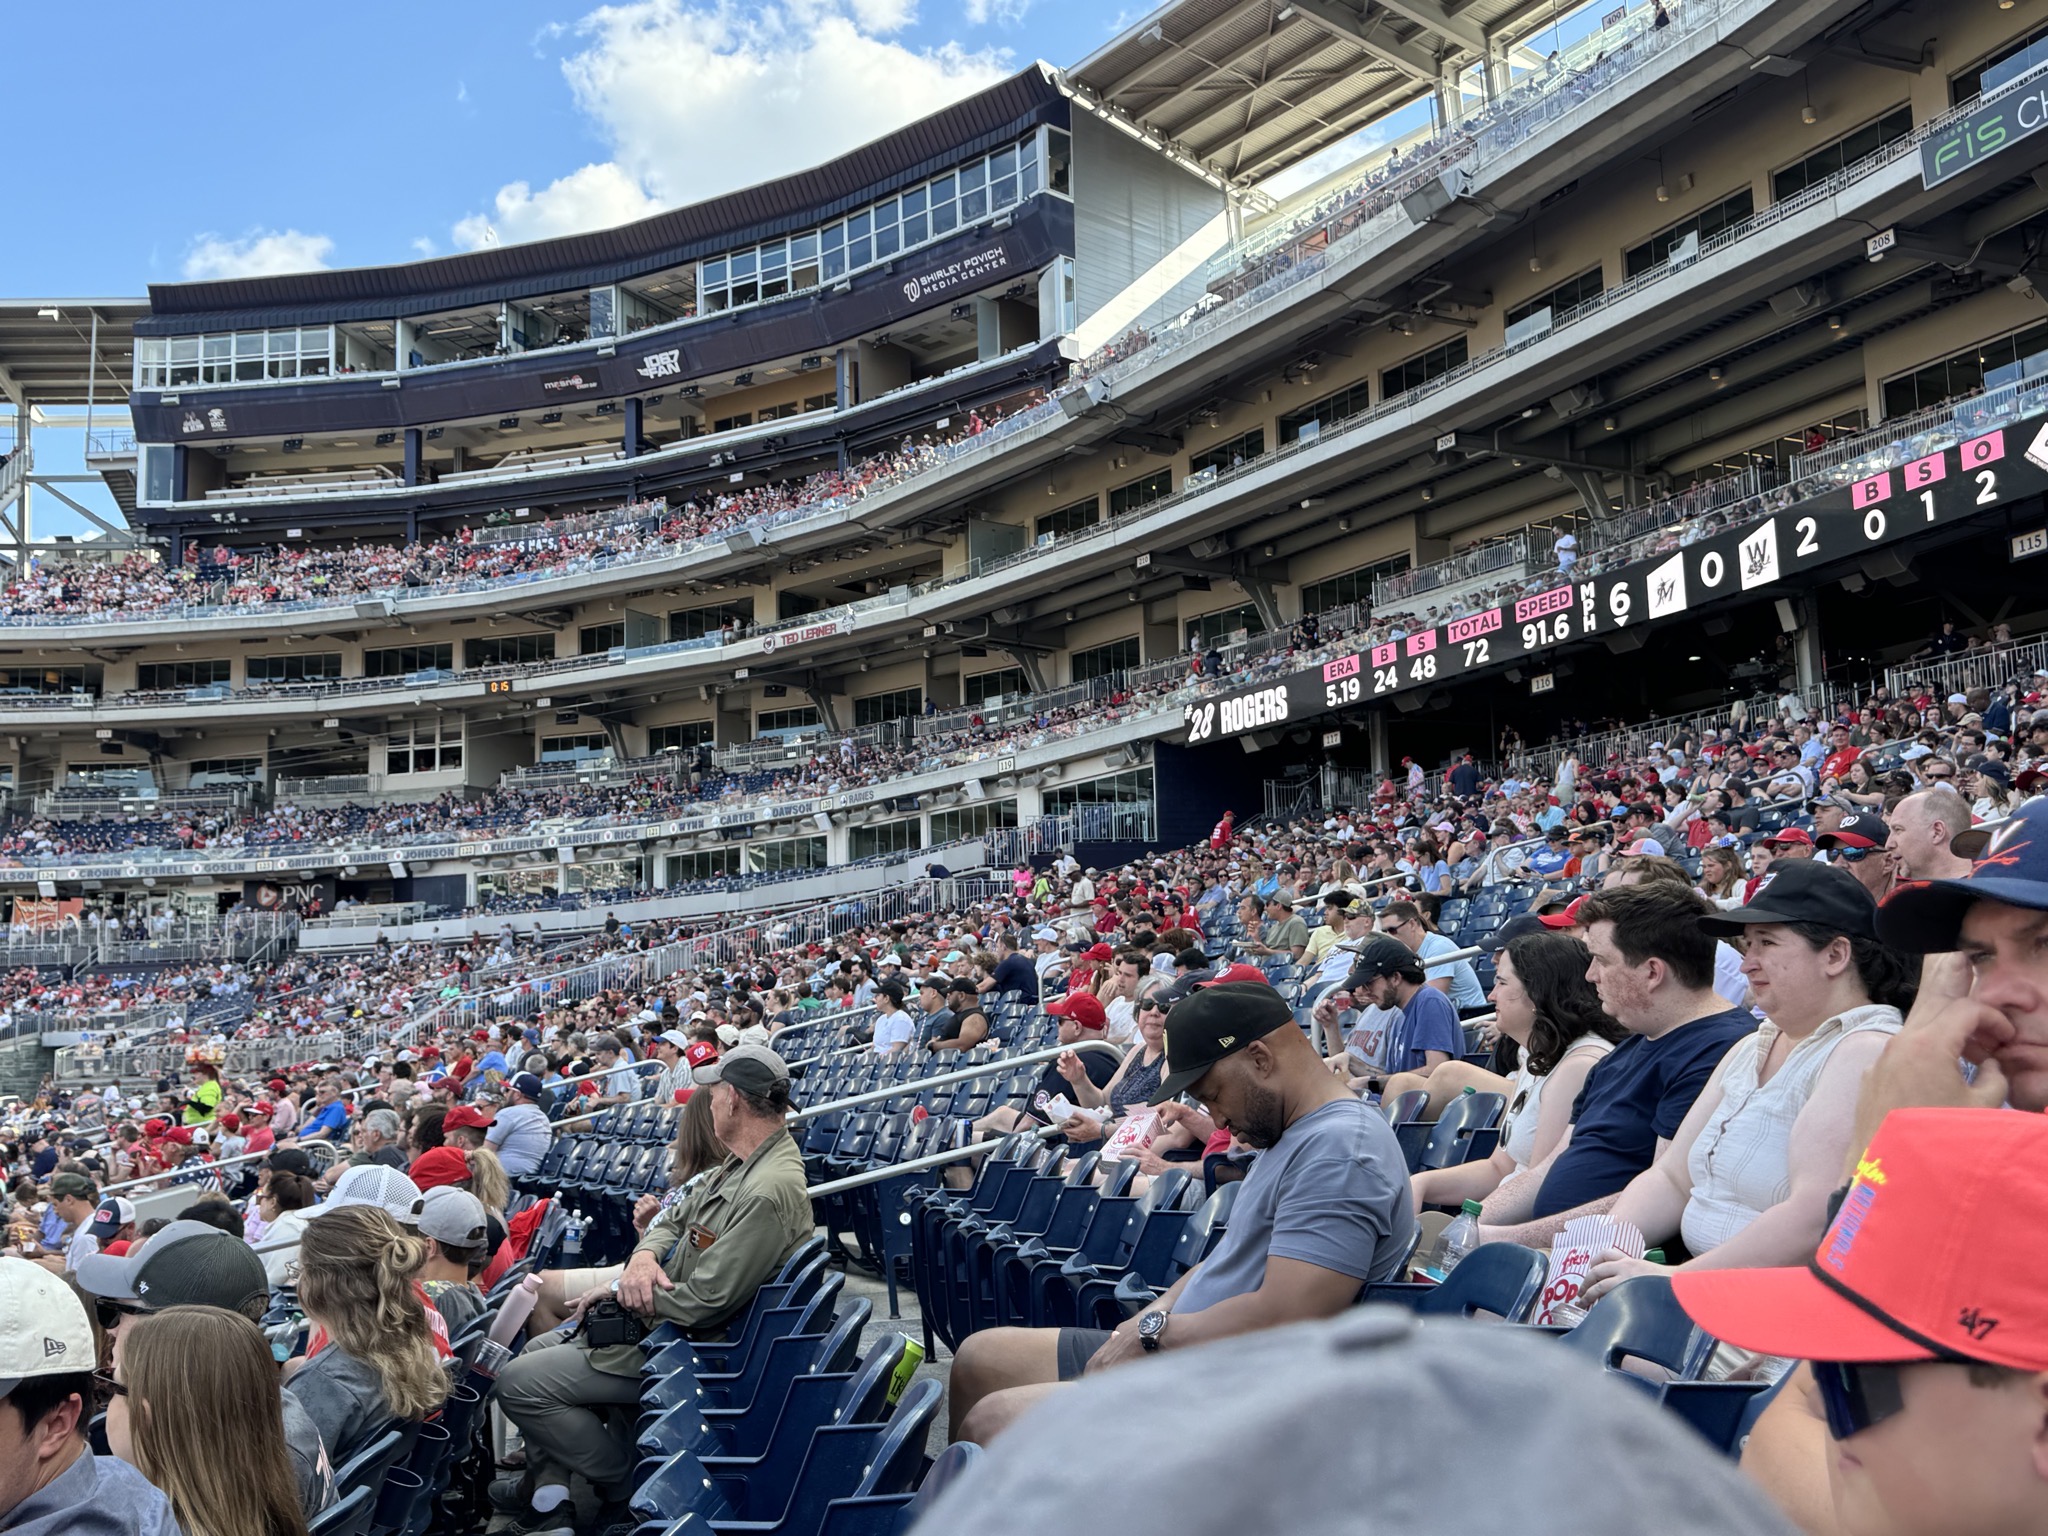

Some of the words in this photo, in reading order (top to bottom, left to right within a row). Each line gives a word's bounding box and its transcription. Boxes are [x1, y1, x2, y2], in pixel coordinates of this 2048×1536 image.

[1872, 234, 1891, 250] 208
[920, 262, 961, 286] SHIRLEY
[959, 246, 1004, 269] POVICH
[923, 276, 954, 295] MEDIA
[956, 257, 1007, 281] CENTER
[649, 361, 681, 379] FAN
[1440, 435, 1453, 448] 209
[1867, 482, 1878, 499] B
[1919, 464, 1932, 481] S
[1974, 440, 1991, 461] O
[1864, 509, 1886, 540] 0
[1920, 489, 1936, 522] 1
[1976, 470, 1998, 505] 2
[1796, 516, 1819, 557] 2
[2018, 534, 2043, 553] 115
[1139, 556, 1148, 565] 210
[1700, 551, 1724, 588] 0
[1609, 581, 1631, 613] 6
[1580, 581, 1597, 633] MPH
[781, 633, 799, 646] TED
[801, 624, 837, 643] LERNER
[1329, 661, 1354, 677] ERA
[1380, 648, 1389, 663] B
[1417, 635, 1426, 650] S
[1450, 617, 1500, 641] TOTAL
[1518, 590, 1570, 619] SPEED
[1326, 677, 1360, 707] 5.19
[1373, 667, 1398, 694] 24
[1410, 654, 1436, 682] 48
[1462, 639, 1490, 668] 72
[1522, 613, 1570, 650] 91.6
[1535, 678, 1551, 690] 116
[1184, 703, 1214, 743] #28
[1220, 685, 1288, 734] ROGERS
[1326, 734, 1338, 745] 117
[1000, 760, 1012, 771] 119
[772, 803, 813, 818] DAWSON
[720, 812, 756, 826] CARTER
[614, 829, 638, 840] RICE
[678, 822, 705, 832] WYNN
[491, 839, 544, 852] KILLEBREW
[558, 833, 600, 845] MANUSH
[289, 855, 334, 868] GRIFFITH
[350, 852, 388, 863] HARRIS
[404, 848, 455, 860] JOHNSON
[79, 869, 121, 880] CRONIN
[138, 864, 186, 876] FERRELL
[204, 862, 246, 873] GOSLIN
[282, 884, 324, 903] PNC
[1562, 1249, 1589, 1273] fresh
